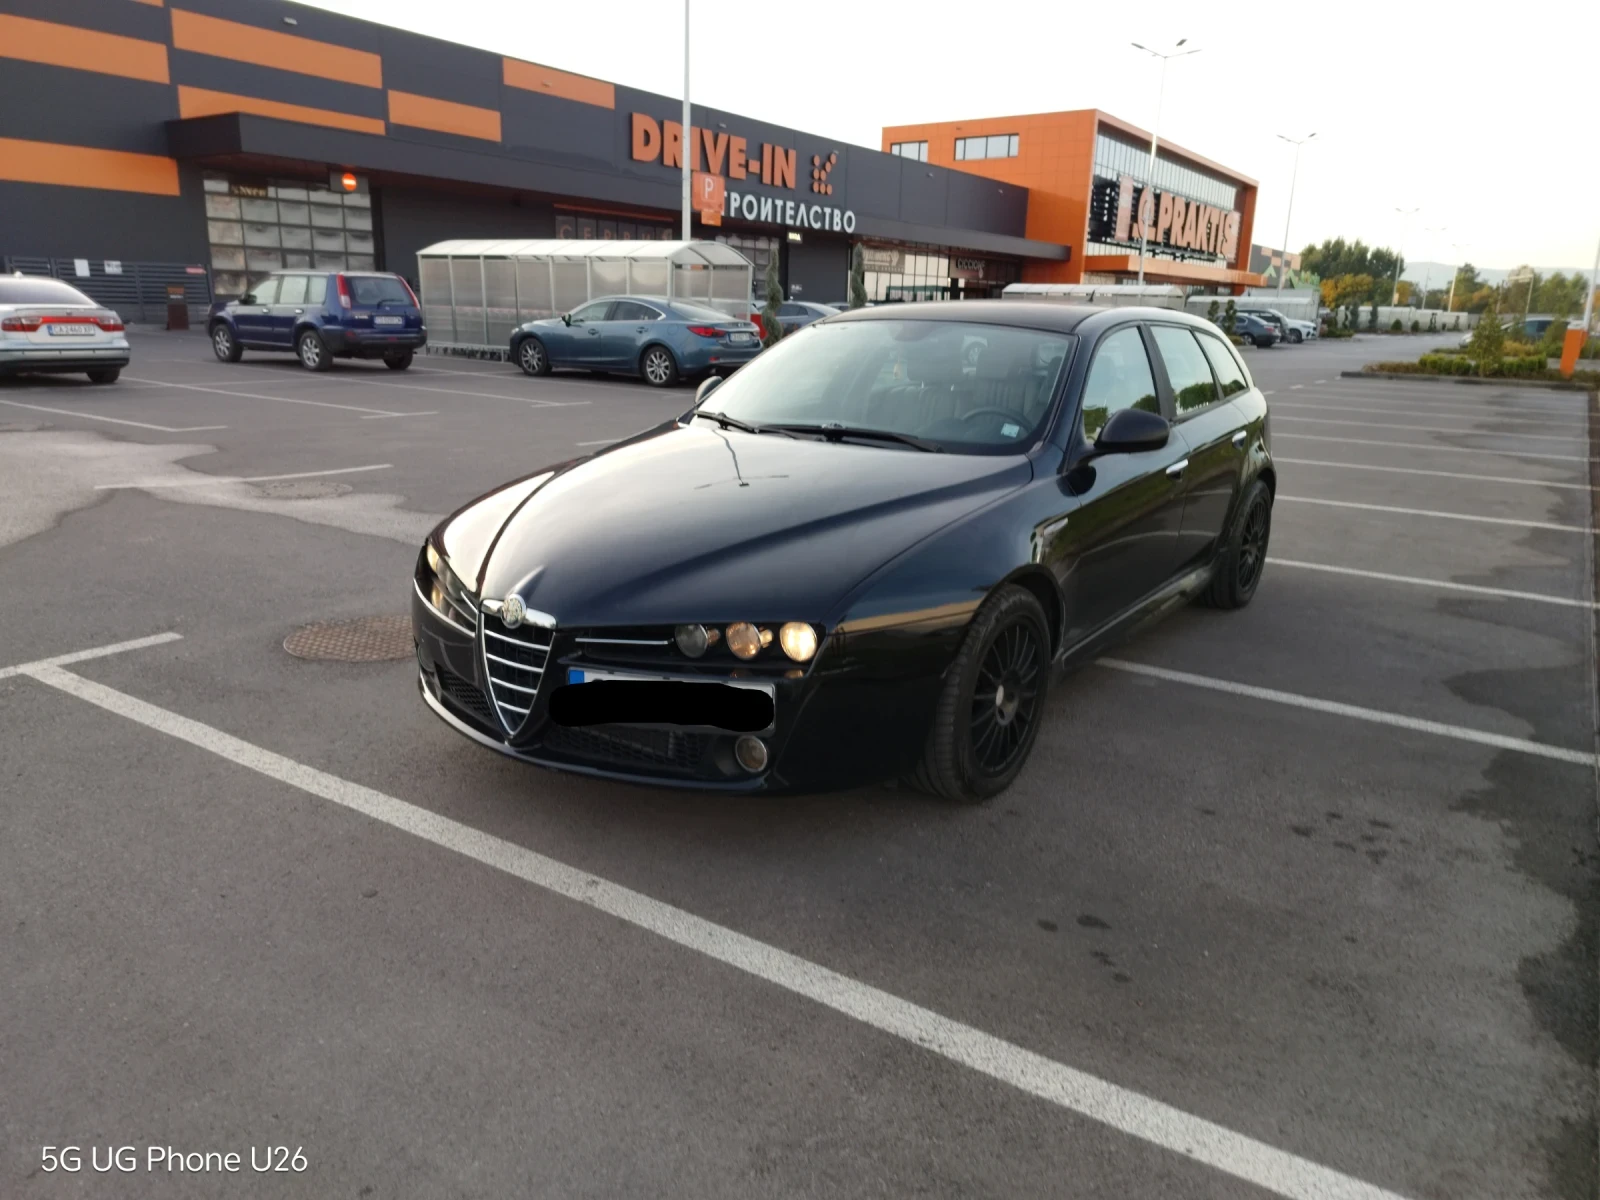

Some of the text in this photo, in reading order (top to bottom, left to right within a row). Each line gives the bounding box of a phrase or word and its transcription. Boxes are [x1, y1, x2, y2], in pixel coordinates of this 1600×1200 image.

[631, 112, 797, 190] DRIVE-IN
[704, 177, 714, 200] P
[724, 190, 856, 234] РОИТЕЛСТВО
[1156, 191, 1239, 261] PRAKTIS
